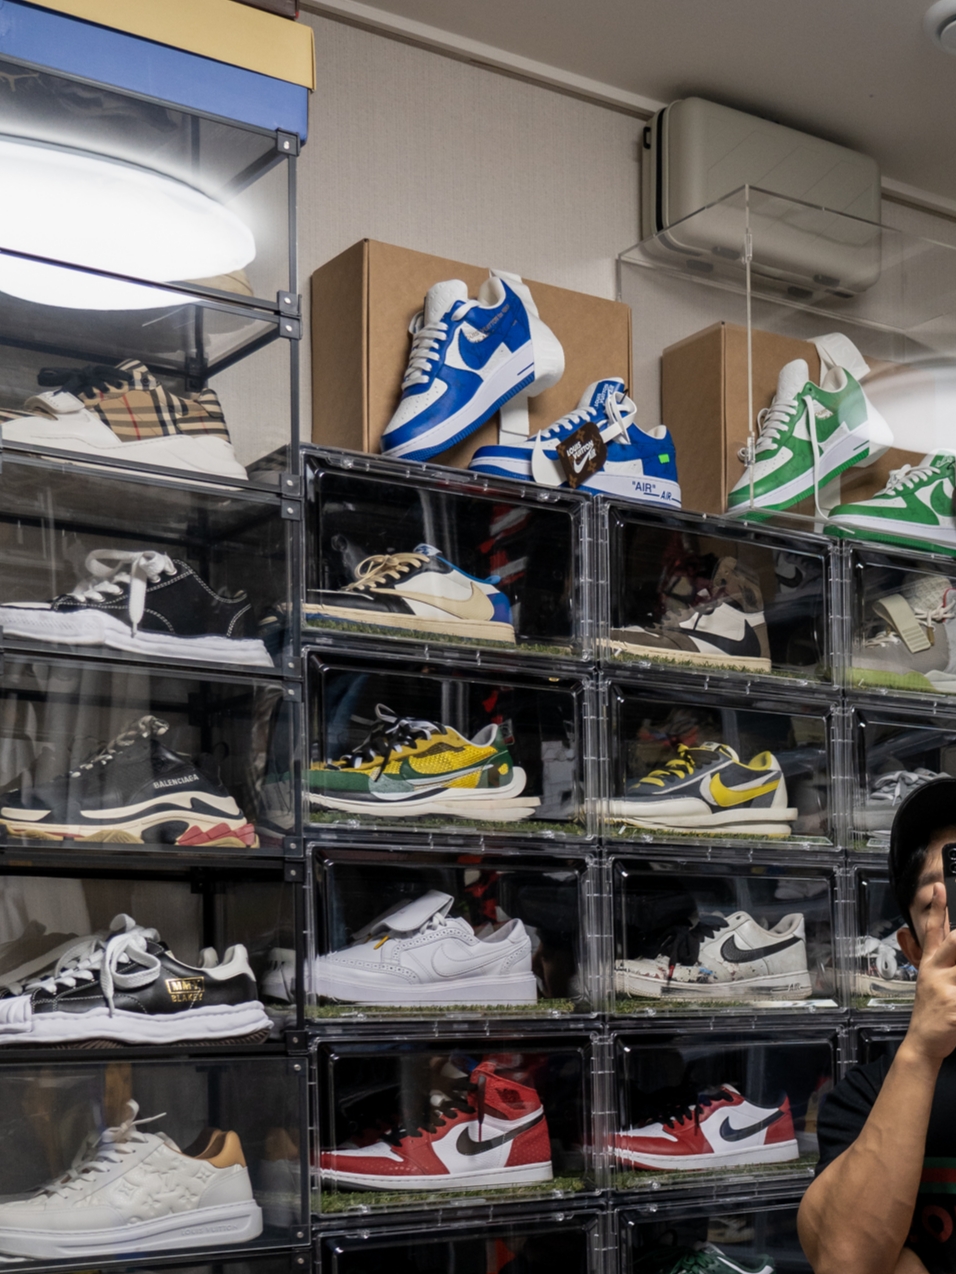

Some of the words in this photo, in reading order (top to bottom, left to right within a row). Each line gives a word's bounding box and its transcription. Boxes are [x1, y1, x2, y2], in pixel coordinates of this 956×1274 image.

[566, 441, 581, 457] LOUIS
[572, 439, 594, 460] VUITTON
[632, 480, 656, 492] "AIR"
[661, 491, 672, 500] AIR
[153, 773, 200, 789] BALENCIAGA
